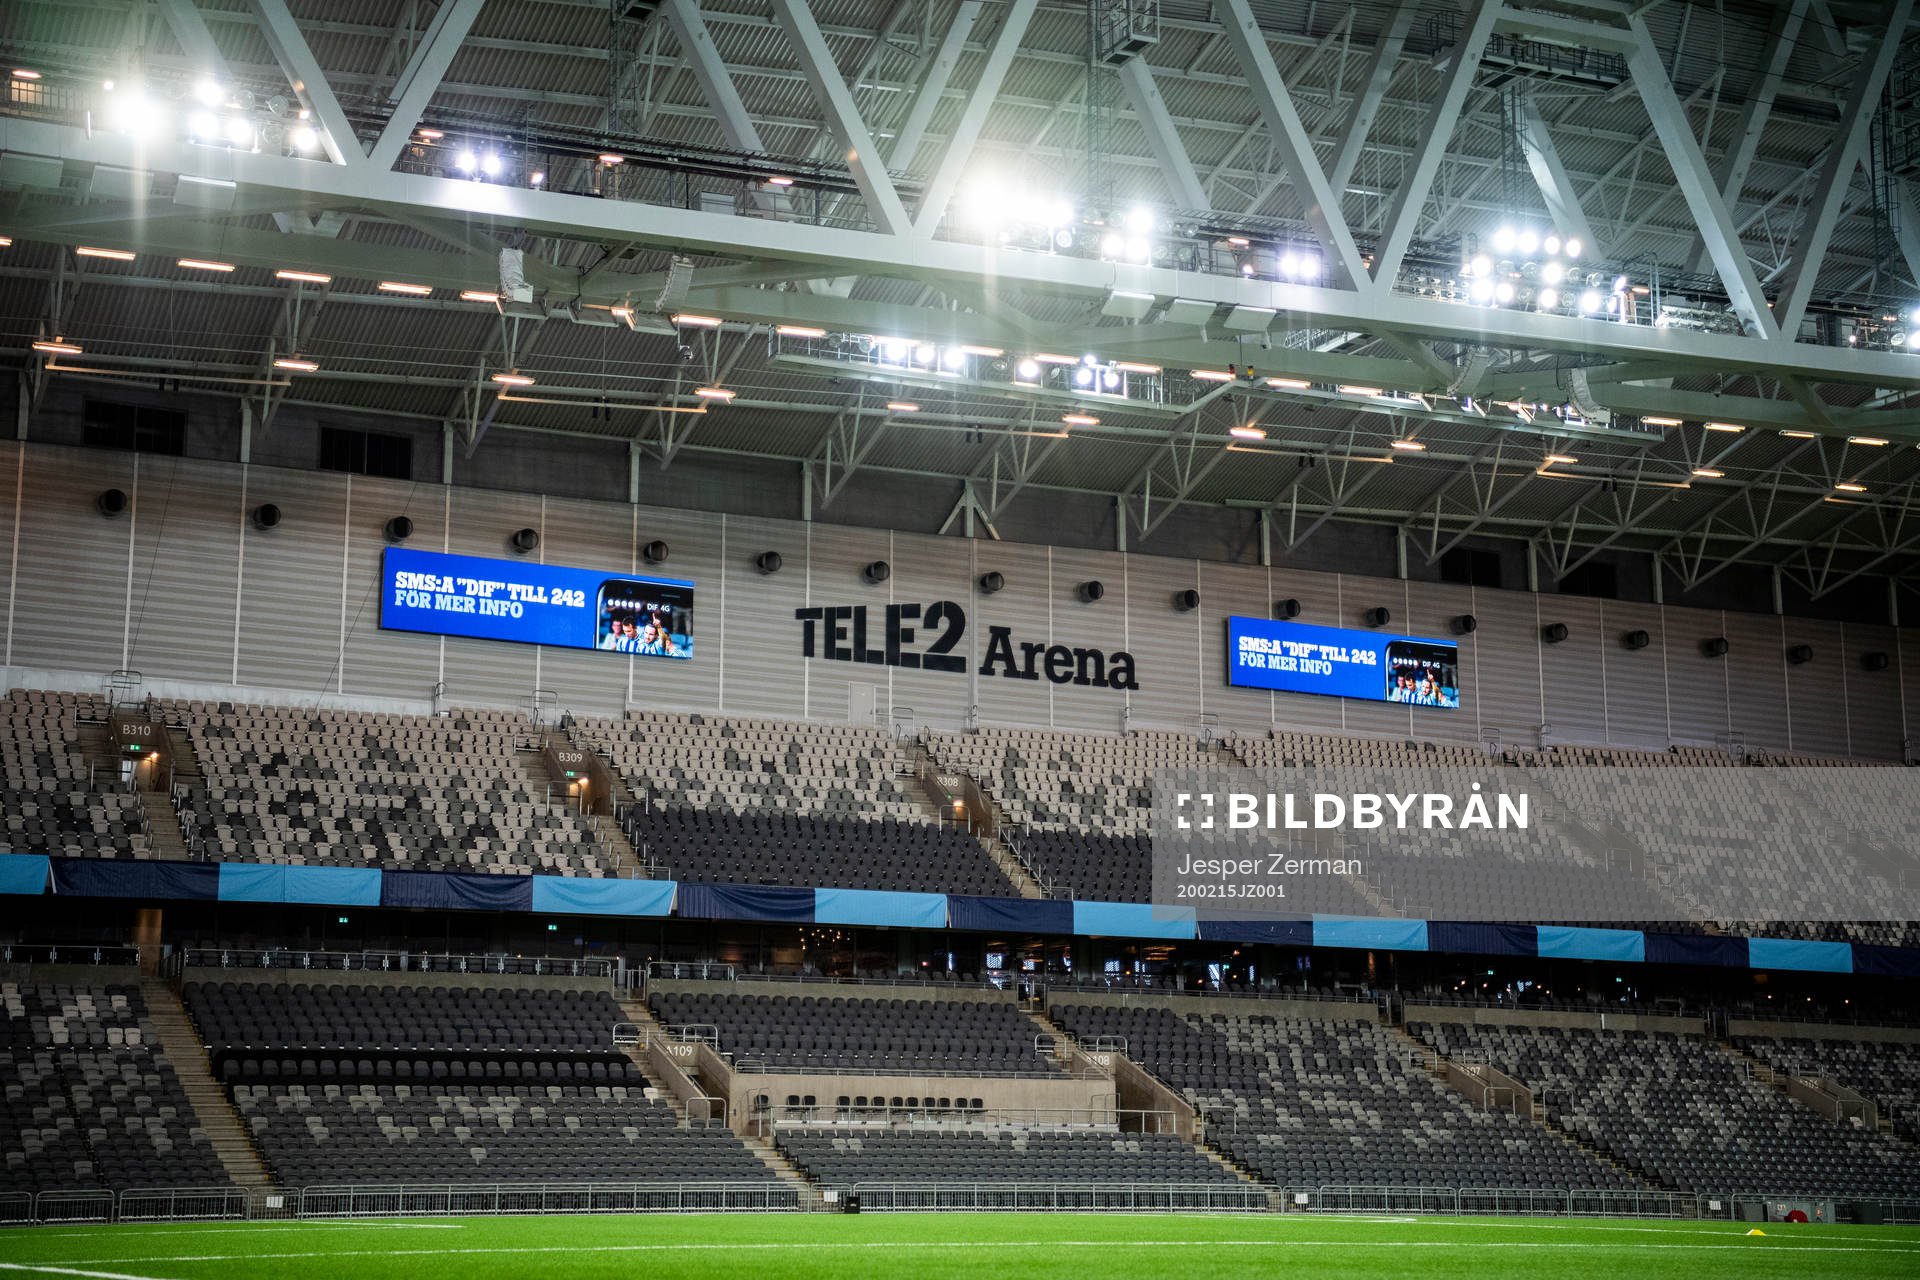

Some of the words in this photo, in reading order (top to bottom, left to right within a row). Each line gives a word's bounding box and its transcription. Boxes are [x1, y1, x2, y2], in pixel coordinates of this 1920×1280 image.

[394, 589, 431, 610] FÖR
[434, 593, 475, 614] MER
[478, 598, 523, 619] INFO
[395, 571, 455, 594] SMS:A
[507, 583, 548, 603] TILL
[550, 588, 585, 607] 242
[795, 600, 967, 674] TELE2
[979, 625, 1139, 691] Arena
[1239, 635, 1282, 655] SMS:A
[1319, 645, 1349, 662] TILL
[1351, 649, 1377, 666] 242
[1239, 651, 1266, 669] FÖR
[1267, 654, 1298, 672] MER
[1299, 658, 1333, 676] INFO
[122, 724, 151, 736] B310
[558, 752, 583, 763] B309
